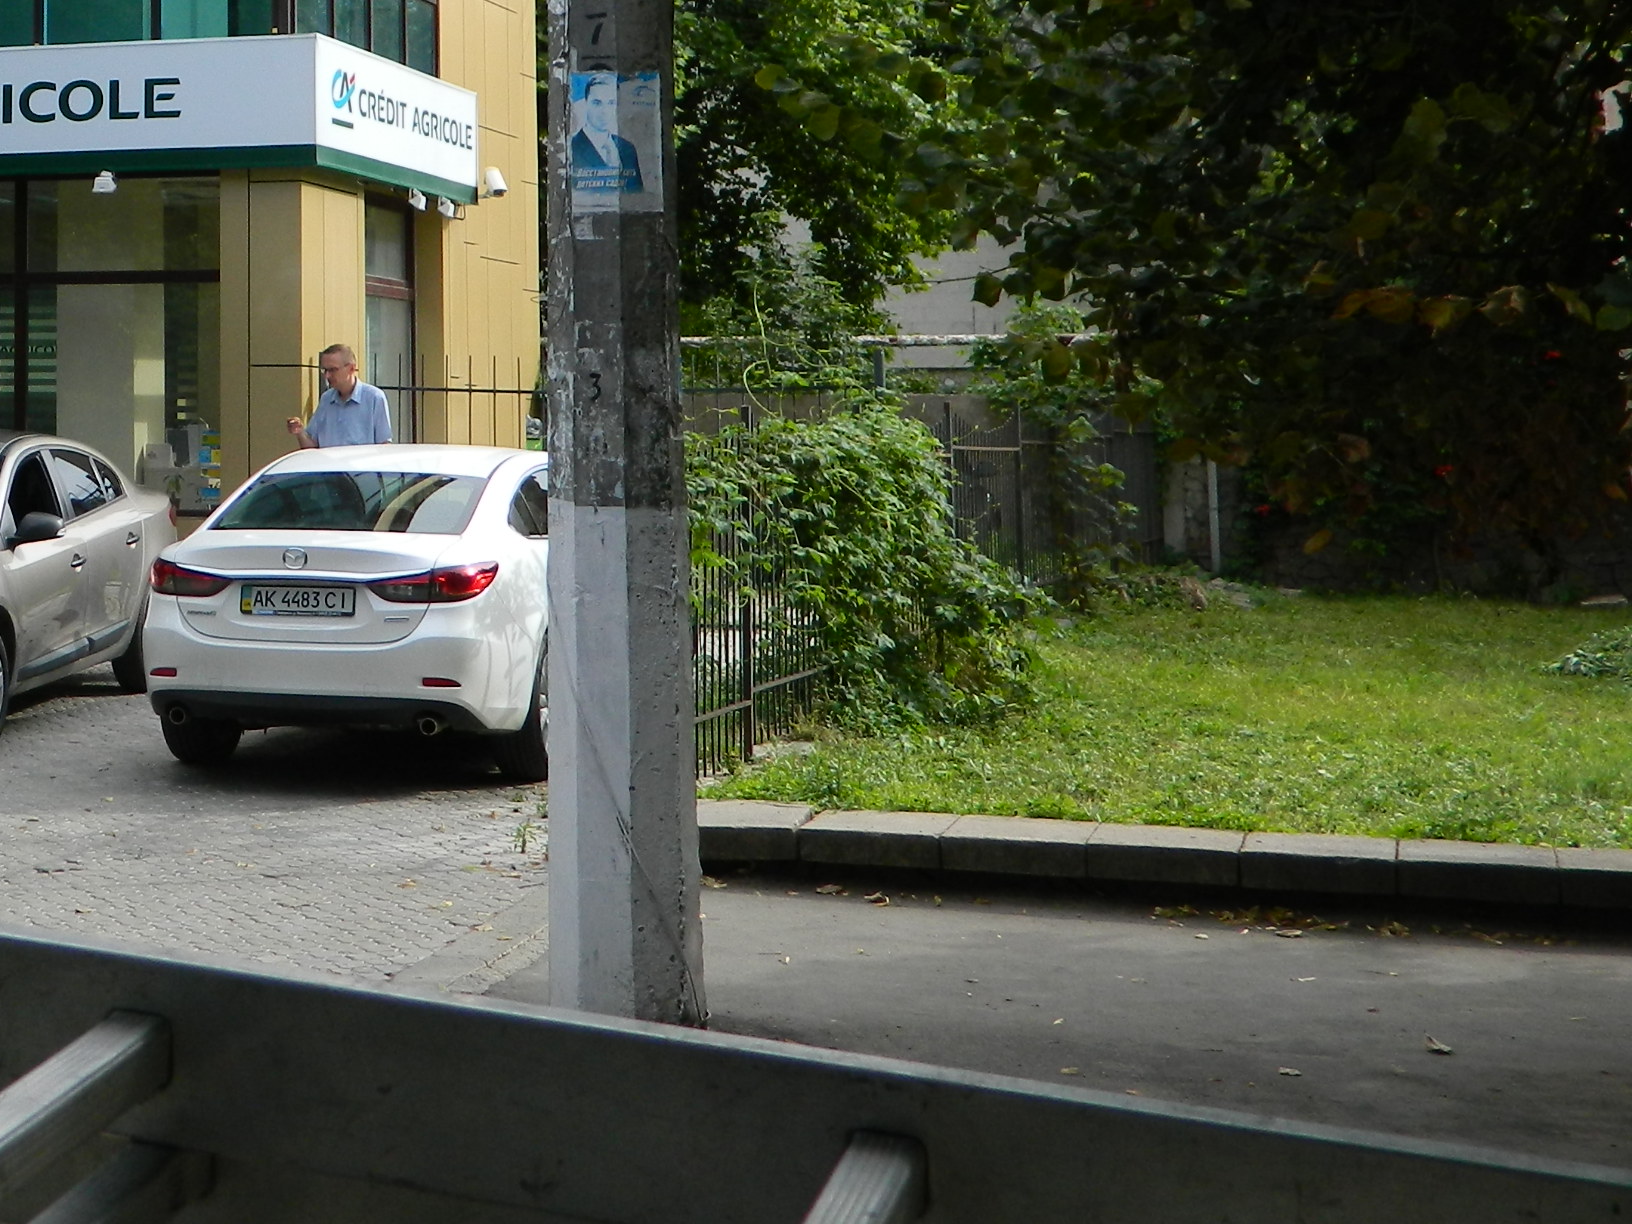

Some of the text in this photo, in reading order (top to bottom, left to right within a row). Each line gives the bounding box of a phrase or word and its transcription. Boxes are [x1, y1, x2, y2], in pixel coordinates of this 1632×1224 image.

[358, 89, 407, 129] CRÉDIT
[412, 107, 473, 150] AGRICOLE
[253, 590, 277, 607] AK
[281, 590, 320, 608] 4483
